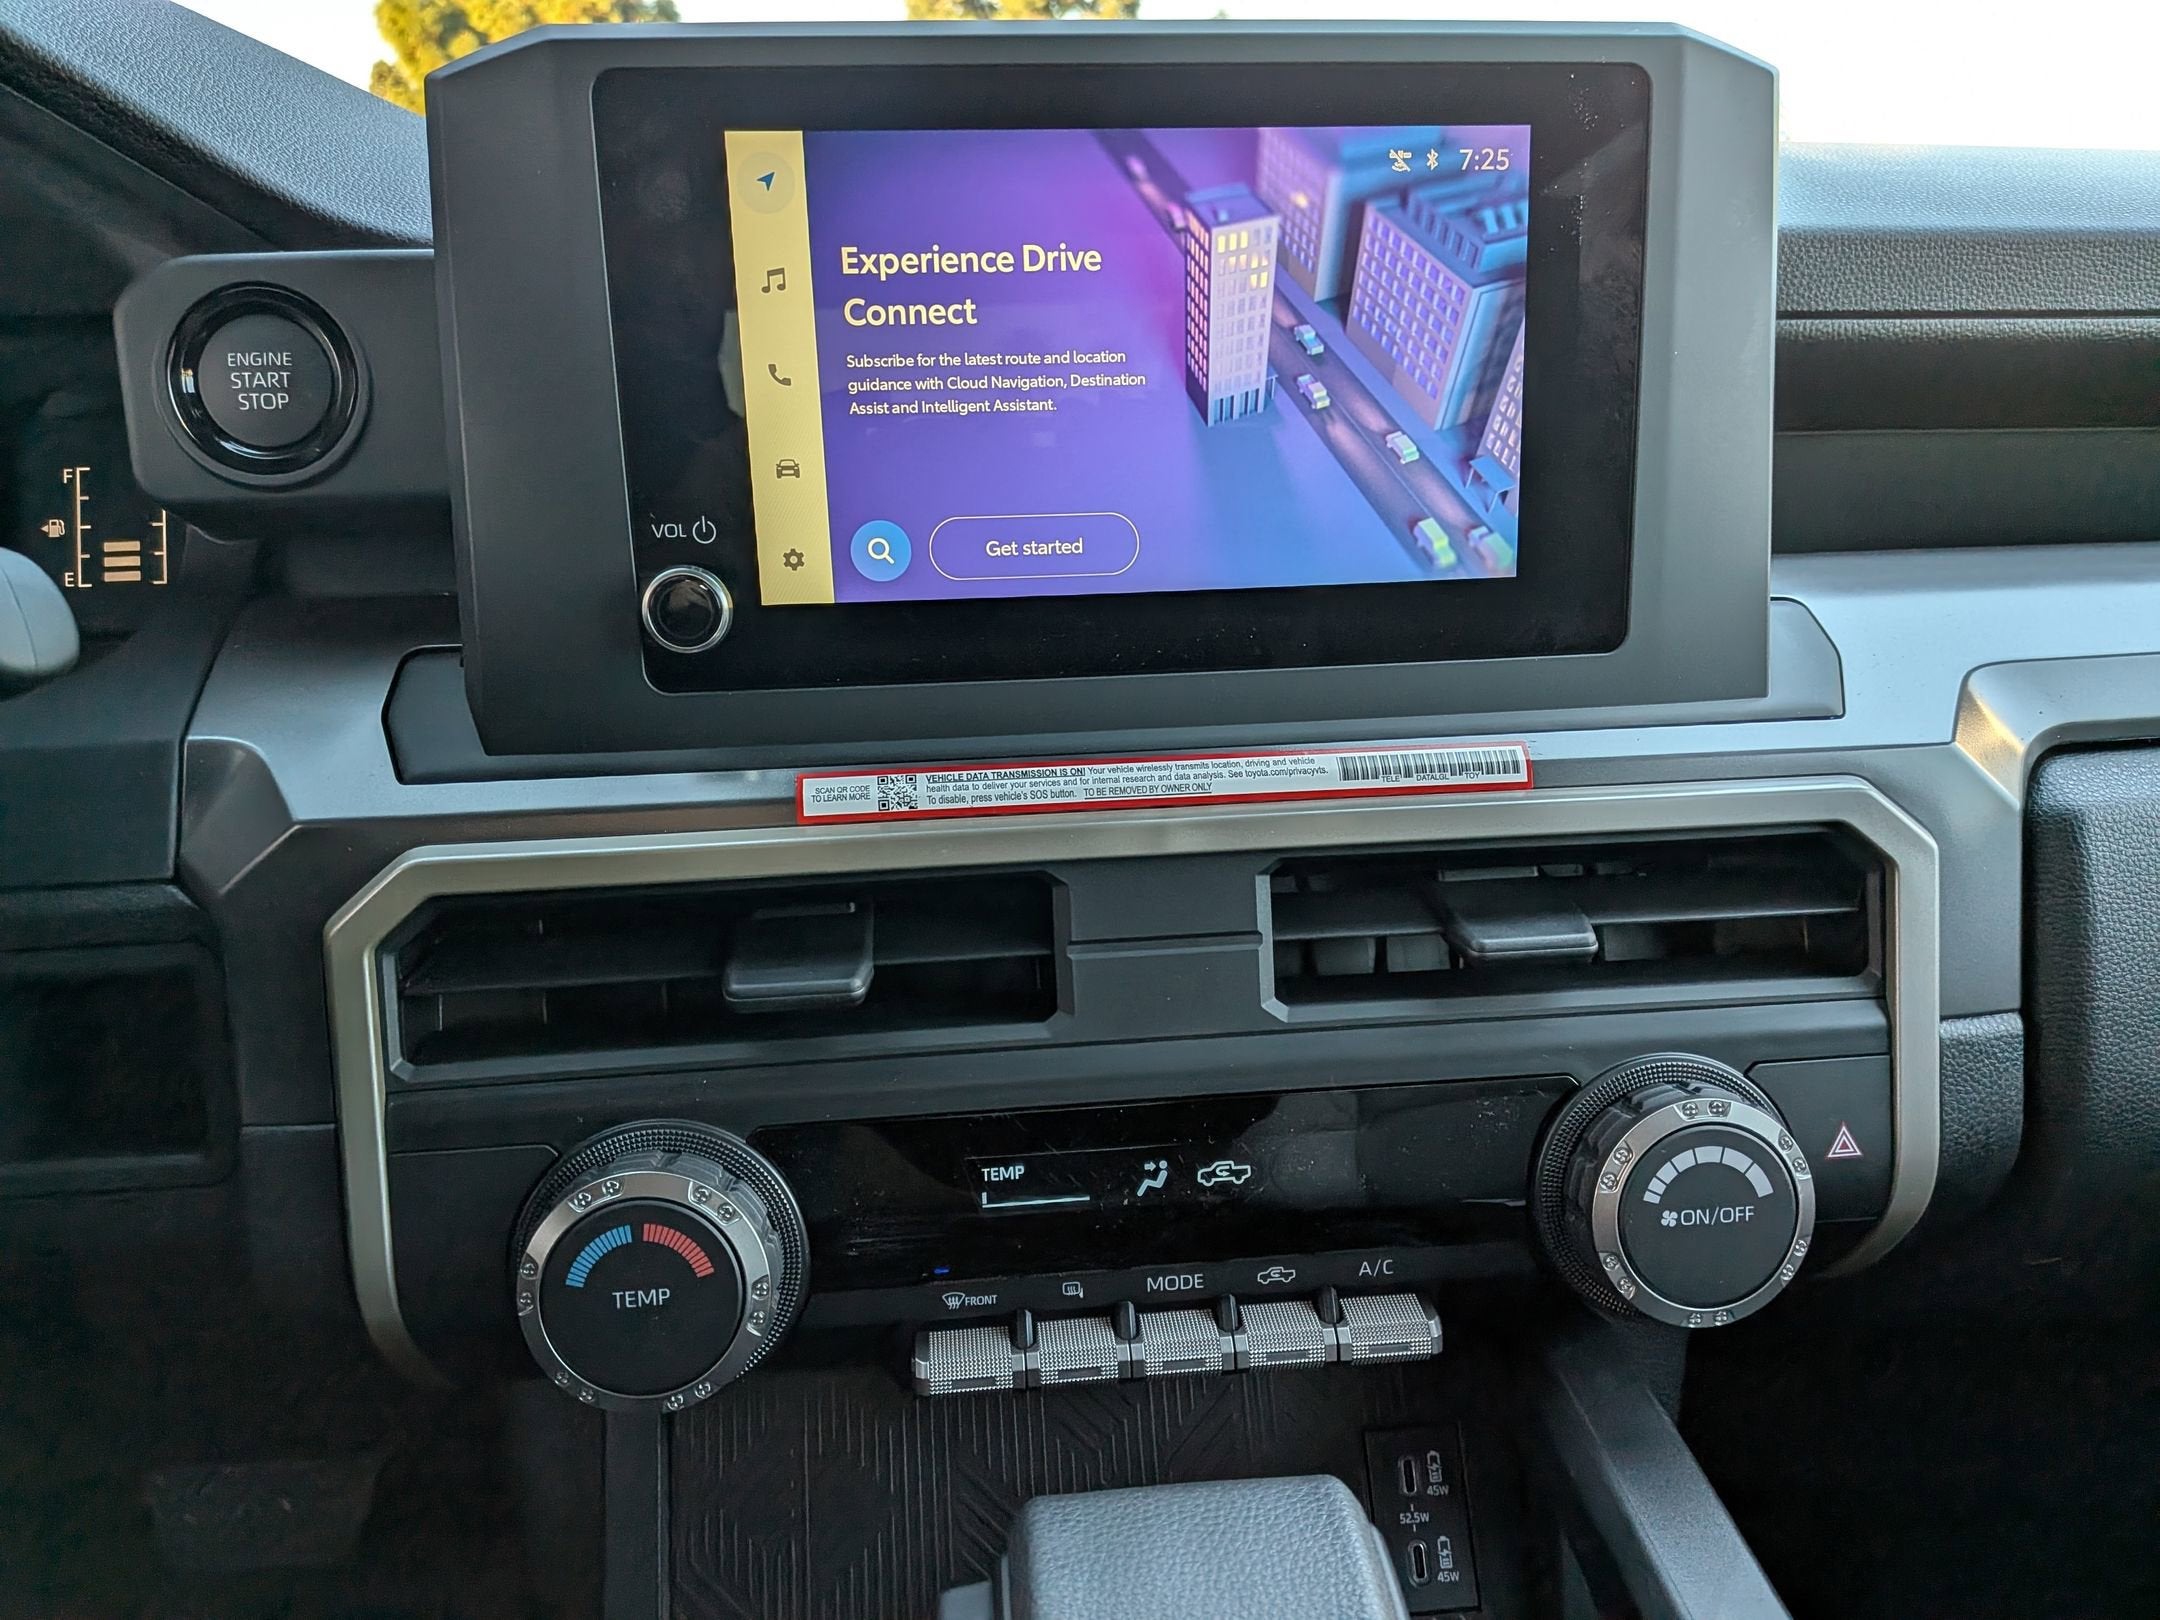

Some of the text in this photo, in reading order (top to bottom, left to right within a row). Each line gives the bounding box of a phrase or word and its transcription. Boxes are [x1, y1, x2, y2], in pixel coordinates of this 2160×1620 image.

[1459, 148, 1510, 171] 7:25
[840, 243, 1103, 281] Experience Drive
[843, 297, 978, 326] Connect
[227, 352, 293, 367] ENGINE
[846, 350, 1126, 368] Subscribe for the latest route and location
[230, 372, 291, 389] START
[848, 373, 1146, 394] guidance with Cloud Navigation, Destination
[238, 393, 289, 410] STOP
[849, 399, 1057, 416] Assist and Intelligent Assistant.
[63, 468, 73, 484] F
[651, 523, 687, 538] VOL
[985, 537, 1083, 557] Get started
[64, 572, 75, 587] E
[926, 773, 964, 783] VEHICLE
[966, 772, 989, 781] DATA
[991, 768, 1058, 780] TRANSMISSION
[1060, 768, 1068, 777] IS
[1088, 766, 1105, 775] Your
[1107, 764, 1134, 774] vehicle
[1136, 762, 1173, 773] wirelessly
[1175, 761, 1210, 770] transmits
[1211, 760, 1243, 769] location,
[1245, 759, 1270, 769] driving
[1272, 758, 1287, 766] and
[1289, 757, 1316, 765] vehicle
[1381, 772, 1480, 783] TELE DATALGL TOY
[926, 783, 950, 793] health
[952, 783, 969, 791] data
[982, 781, 1007, 791] deliver
[1010, 781, 1027, 790] your
[1029, 779, 1061, 788] services
[1063, 778, 1078, 786] and
[1080, 777, 1089, 785] for
[1092, 776, 1120, 785] internal
[1122, 774, 1155, 783] research
[1157, 773, 1172, 781] and
[1174, 771, 1191, 780] data
[1194, 769, 1226, 781] analysis.
[1228, 769, 1243, 778] See
[811, 792, 871, 803] TO LEARN MORE
[814, 785, 870, 795] SCAN QR CODE
[927, 782, 1212, 805] To disable, press vehicle's SOS button. TO BE REMOVED BY OWNER ONLY
[981, 1165, 1025, 1182] TEMP
[1681, 1206, 1755, 1226] ON/OFF
[1359, 1259, 1394, 1277] A/C
[1146, 1273, 1204, 1293] MODE
[612, 1288, 671, 1310] TEMP
[965, 1295, 998, 1306] FRONT
[1426, 1485, 1449, 1496] 45W
[1400, 1512, 1429, 1525] 52.5W
[1437, 1571, 1460, 1582] 45W
